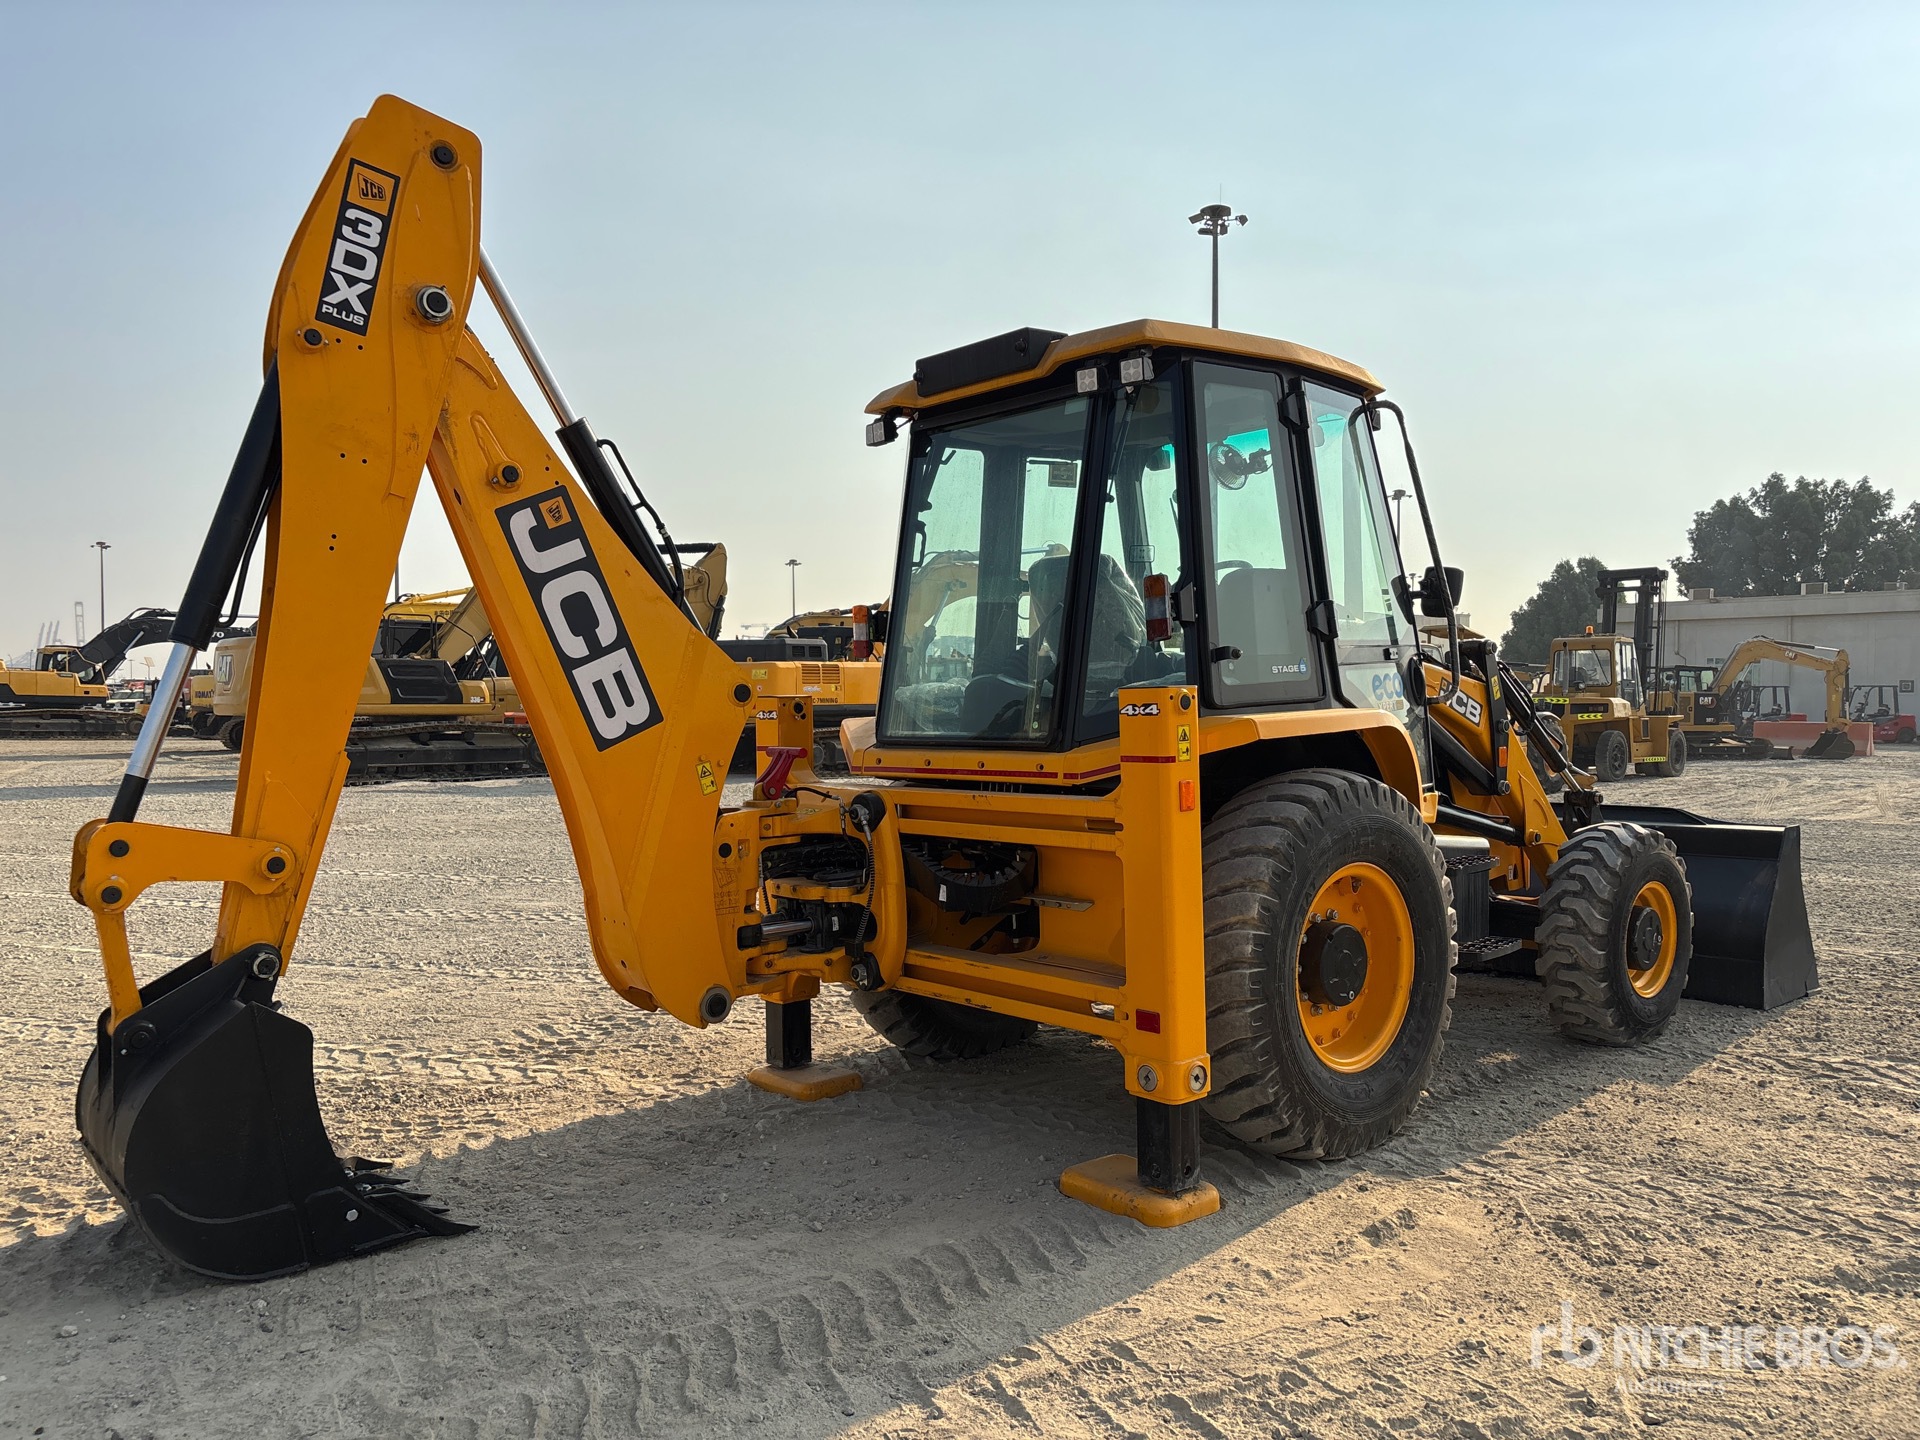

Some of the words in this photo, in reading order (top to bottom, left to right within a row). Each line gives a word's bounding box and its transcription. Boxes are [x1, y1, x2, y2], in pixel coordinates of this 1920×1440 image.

[360, 177, 386, 200] JCB
[322, 208, 384, 316] 3DX
[321, 303, 365, 326] PLUS
[546, 502, 563, 523] JCB
[509, 507, 650, 740] JCB
[1372, 672, 1404, 701] eco
[1699, 697, 1713, 705] CAT
